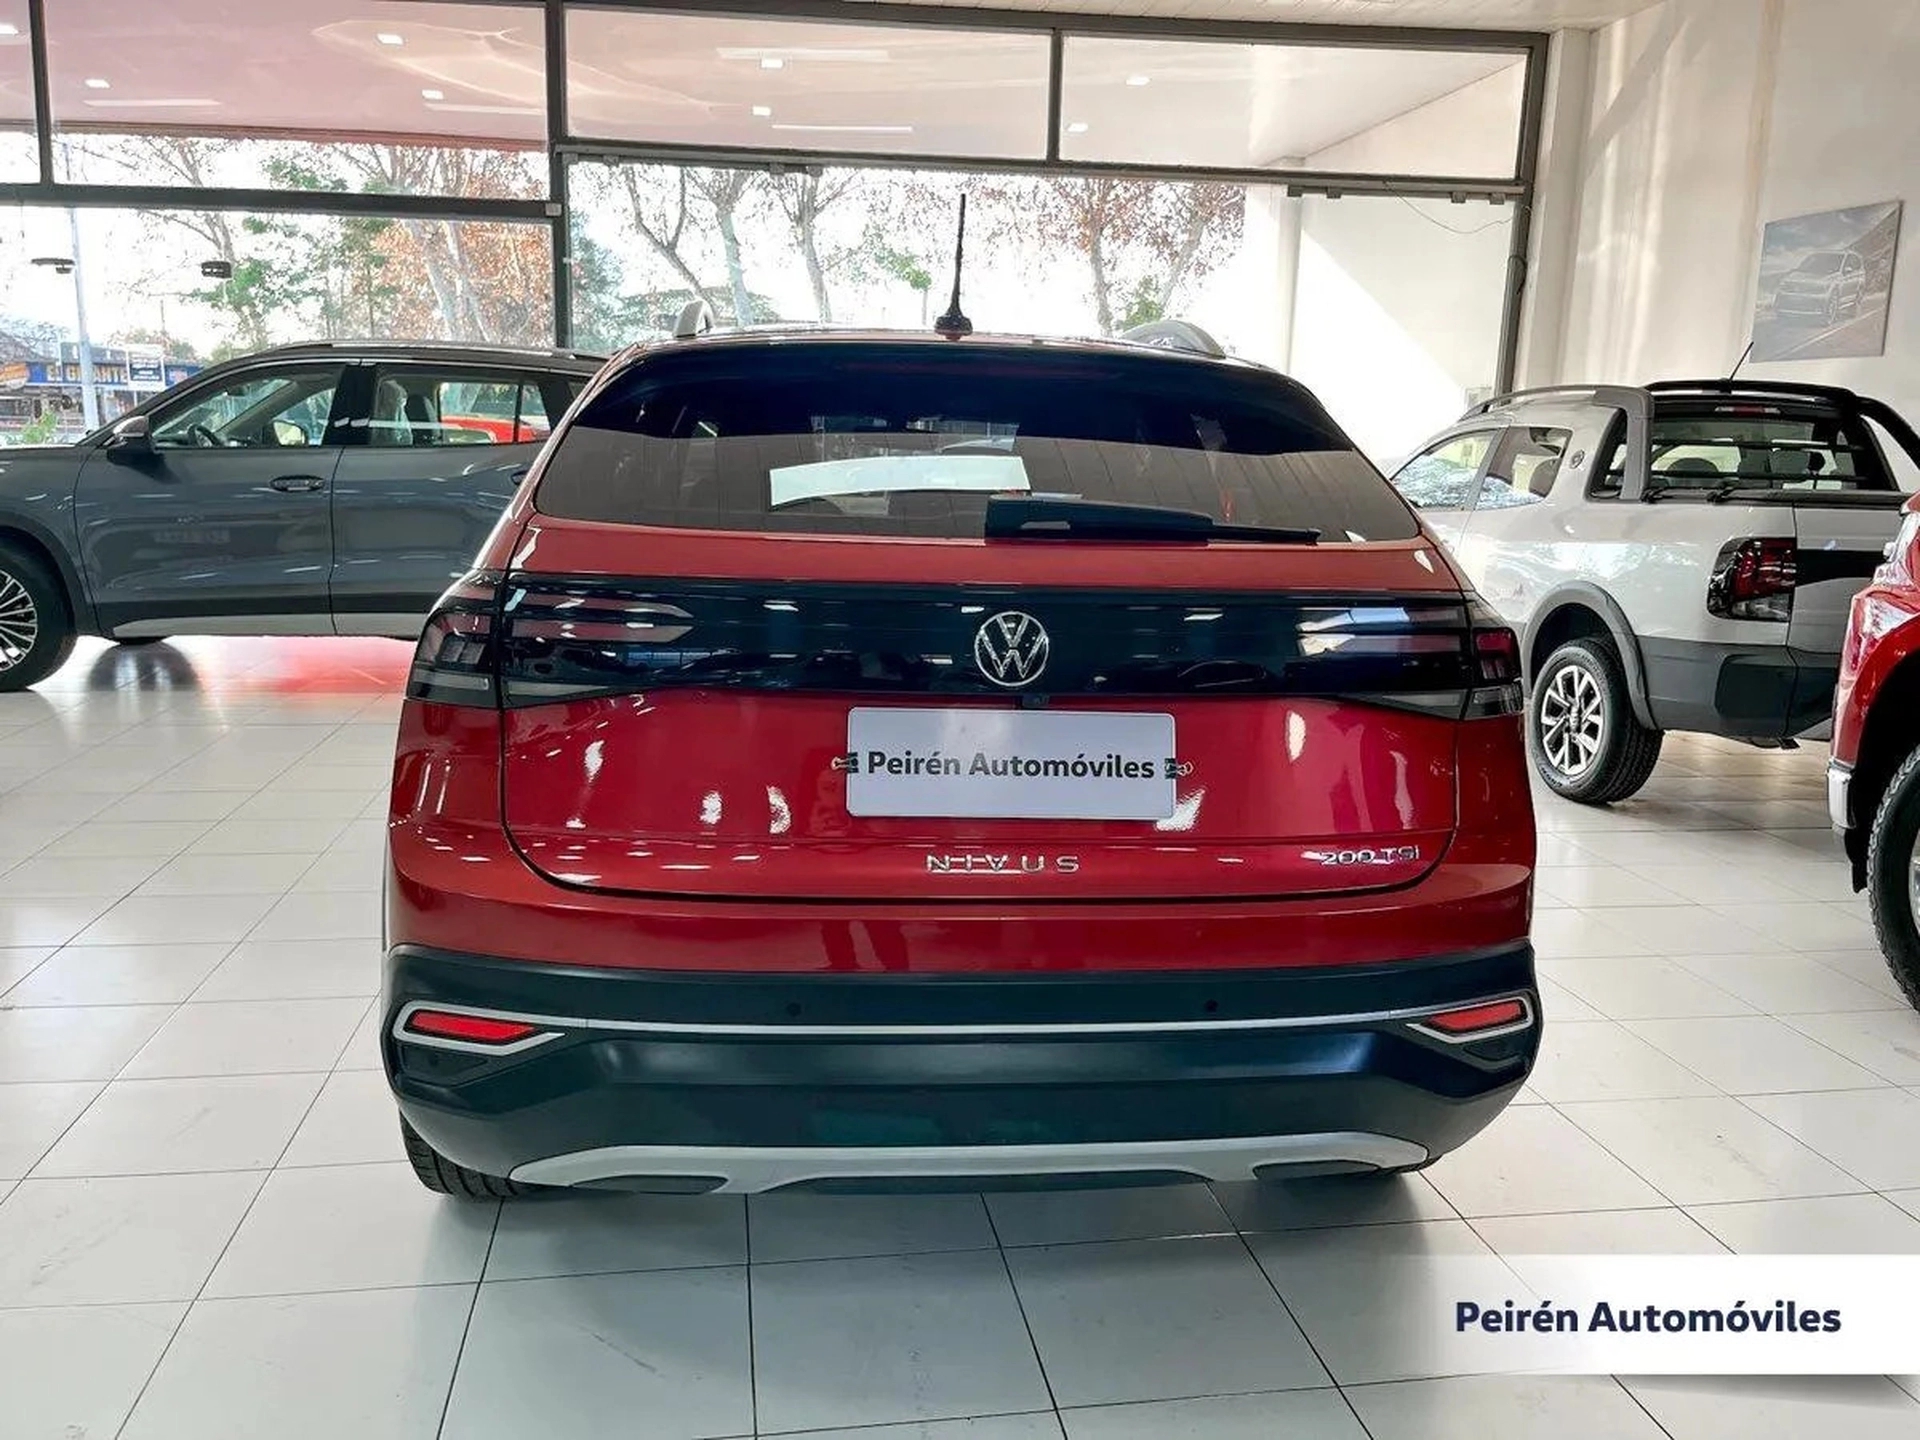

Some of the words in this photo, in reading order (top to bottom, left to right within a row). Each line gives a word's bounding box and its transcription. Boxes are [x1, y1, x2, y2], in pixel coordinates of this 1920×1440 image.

[867, 751, 961, 776] Peirén
[968, 752, 1155, 780] Automóviles
[926, 854, 1080, 874] NIVUS
[1320, 849, 1376, 866] 200
